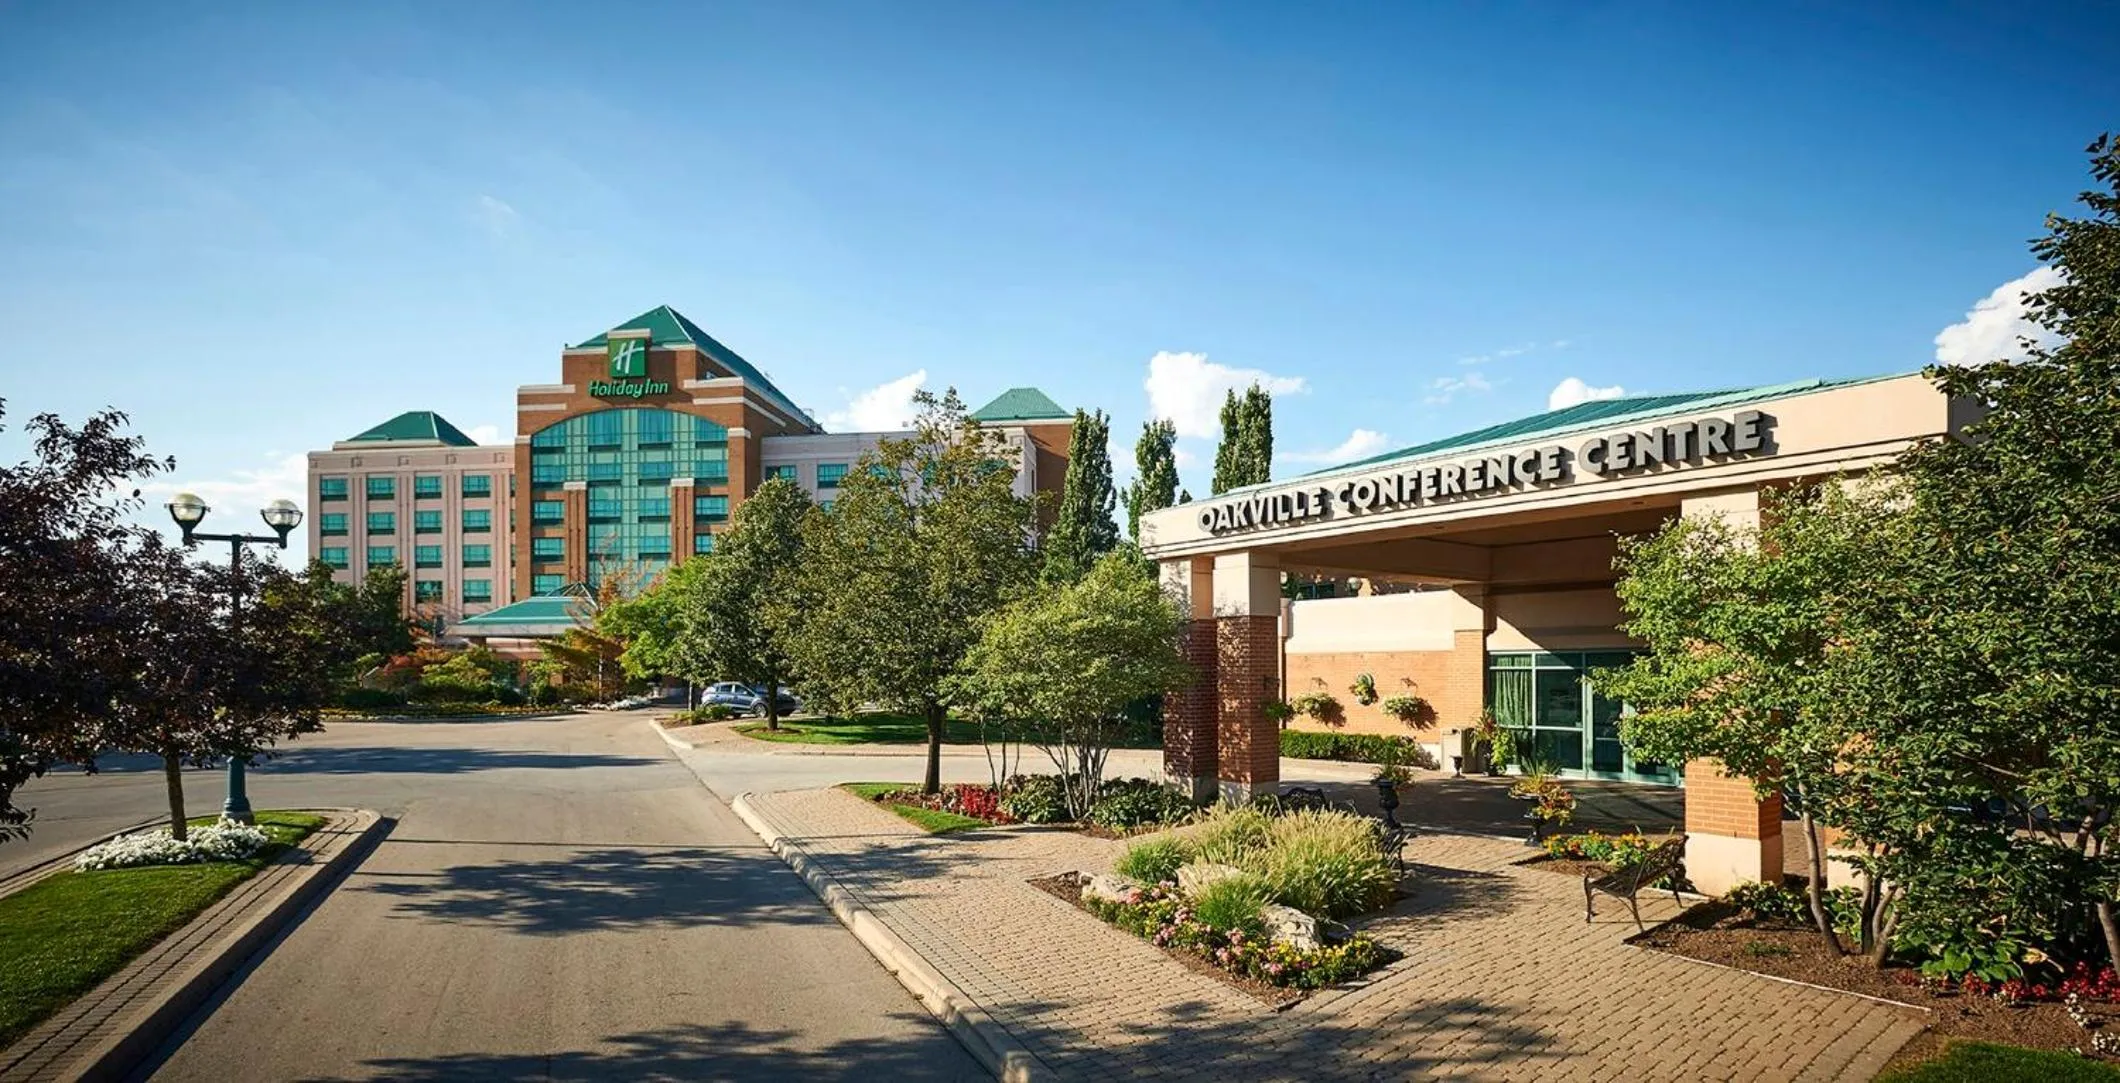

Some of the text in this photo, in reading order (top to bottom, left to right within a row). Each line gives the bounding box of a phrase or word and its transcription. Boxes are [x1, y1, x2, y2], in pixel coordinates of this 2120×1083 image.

[612, 340, 645, 374] H
[588, 378, 669, 398] Holiday Inn
[1199, 409, 1761, 533] OAKVILLE CONFERENCE CENTRE
